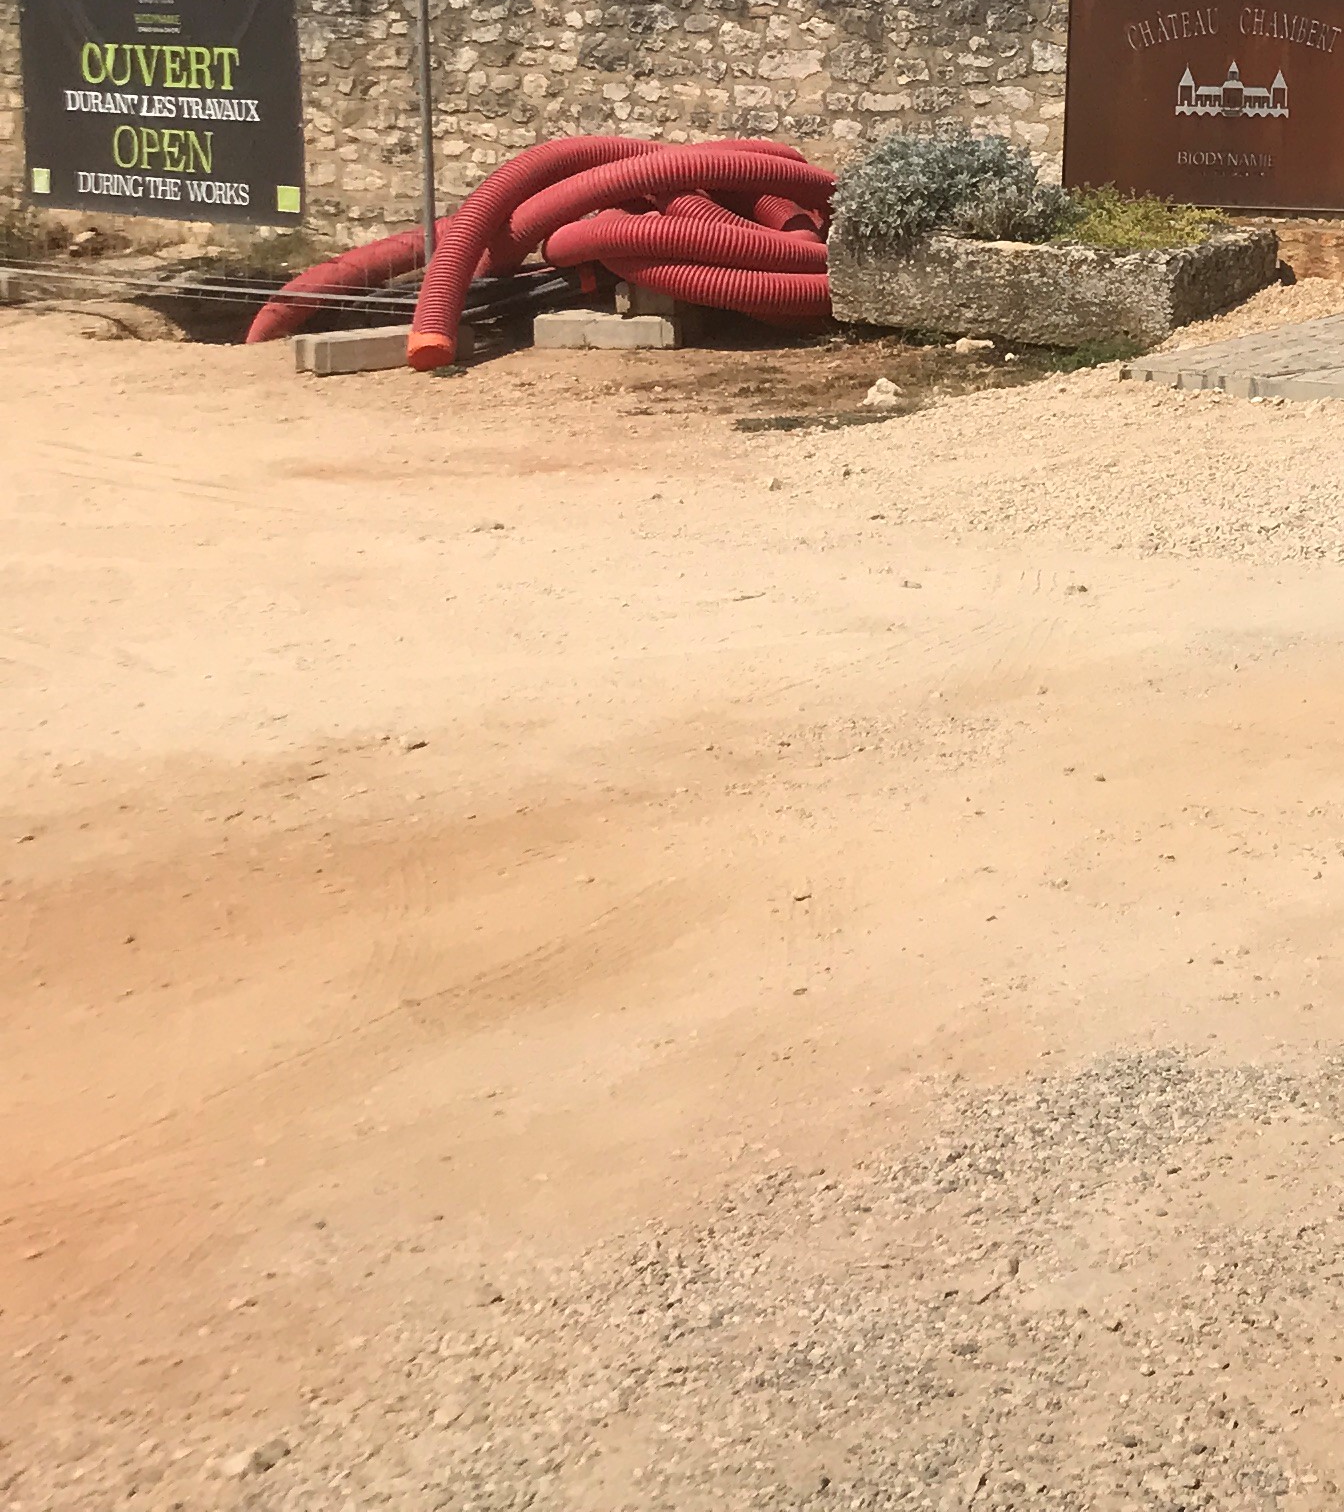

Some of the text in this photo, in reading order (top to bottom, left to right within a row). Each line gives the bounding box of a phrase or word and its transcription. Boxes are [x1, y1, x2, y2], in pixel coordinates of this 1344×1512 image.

[81, 41, 240, 91] OUVERT
[64, 90, 260, 122] DURANT LES TRAVAUX
[112, 125, 214, 174] OPEN
[78, 171, 250, 207] DURING THE WORKS
